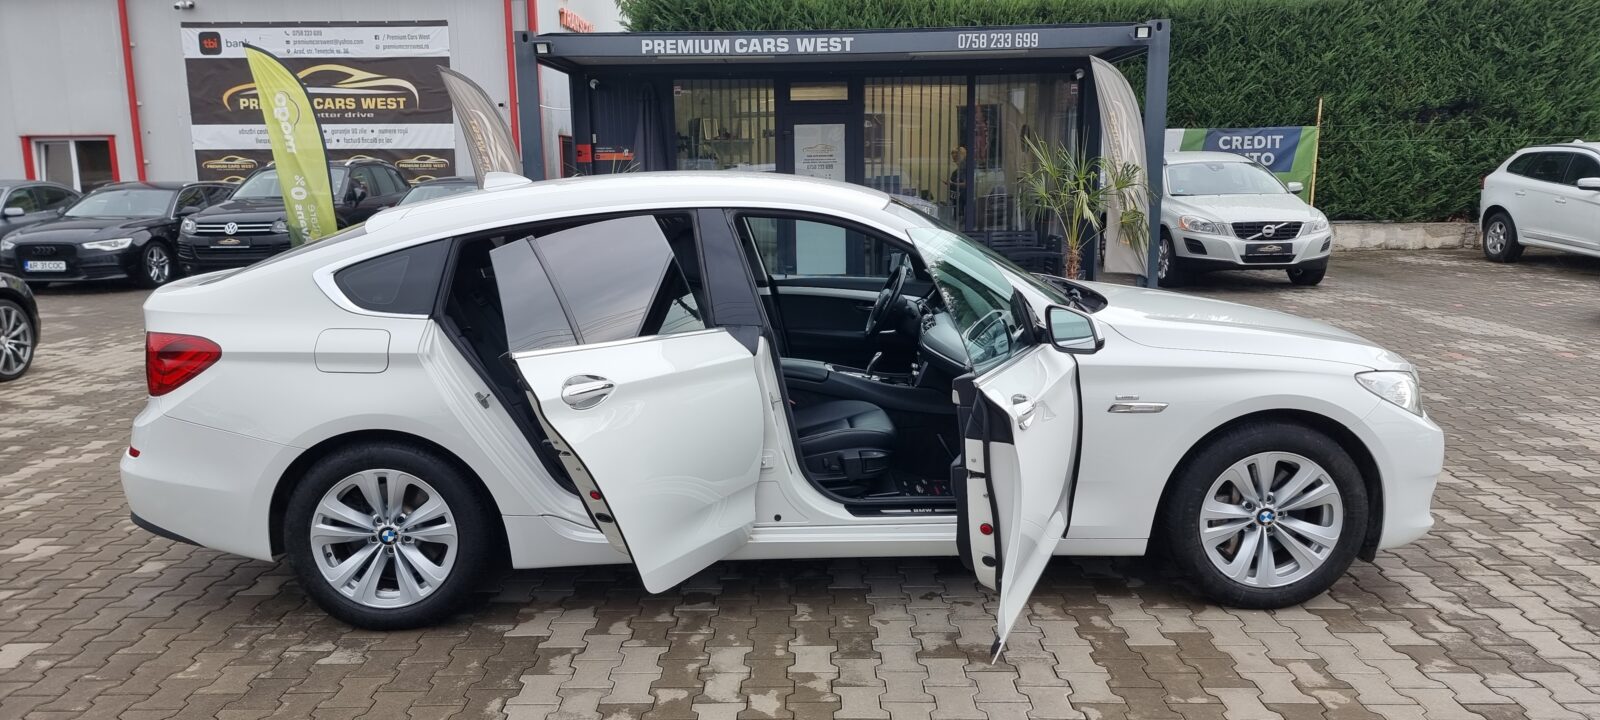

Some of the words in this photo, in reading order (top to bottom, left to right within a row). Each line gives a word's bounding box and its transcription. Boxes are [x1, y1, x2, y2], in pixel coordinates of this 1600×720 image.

[203, 38, 217, 48] tbi
[641, 39, 730, 54] PREMIUM
[734, 37, 789, 53] CARS
[796, 37, 854, 52] WEST
[958, 33, 987, 49] 0758
[990, 33, 1012, 48] 233
[1015, 32, 1039, 48] 699
[313, 97, 356, 110] CARS
[360, 97, 406, 110] WEST
[1218, 135, 1284, 150] CREDIT
